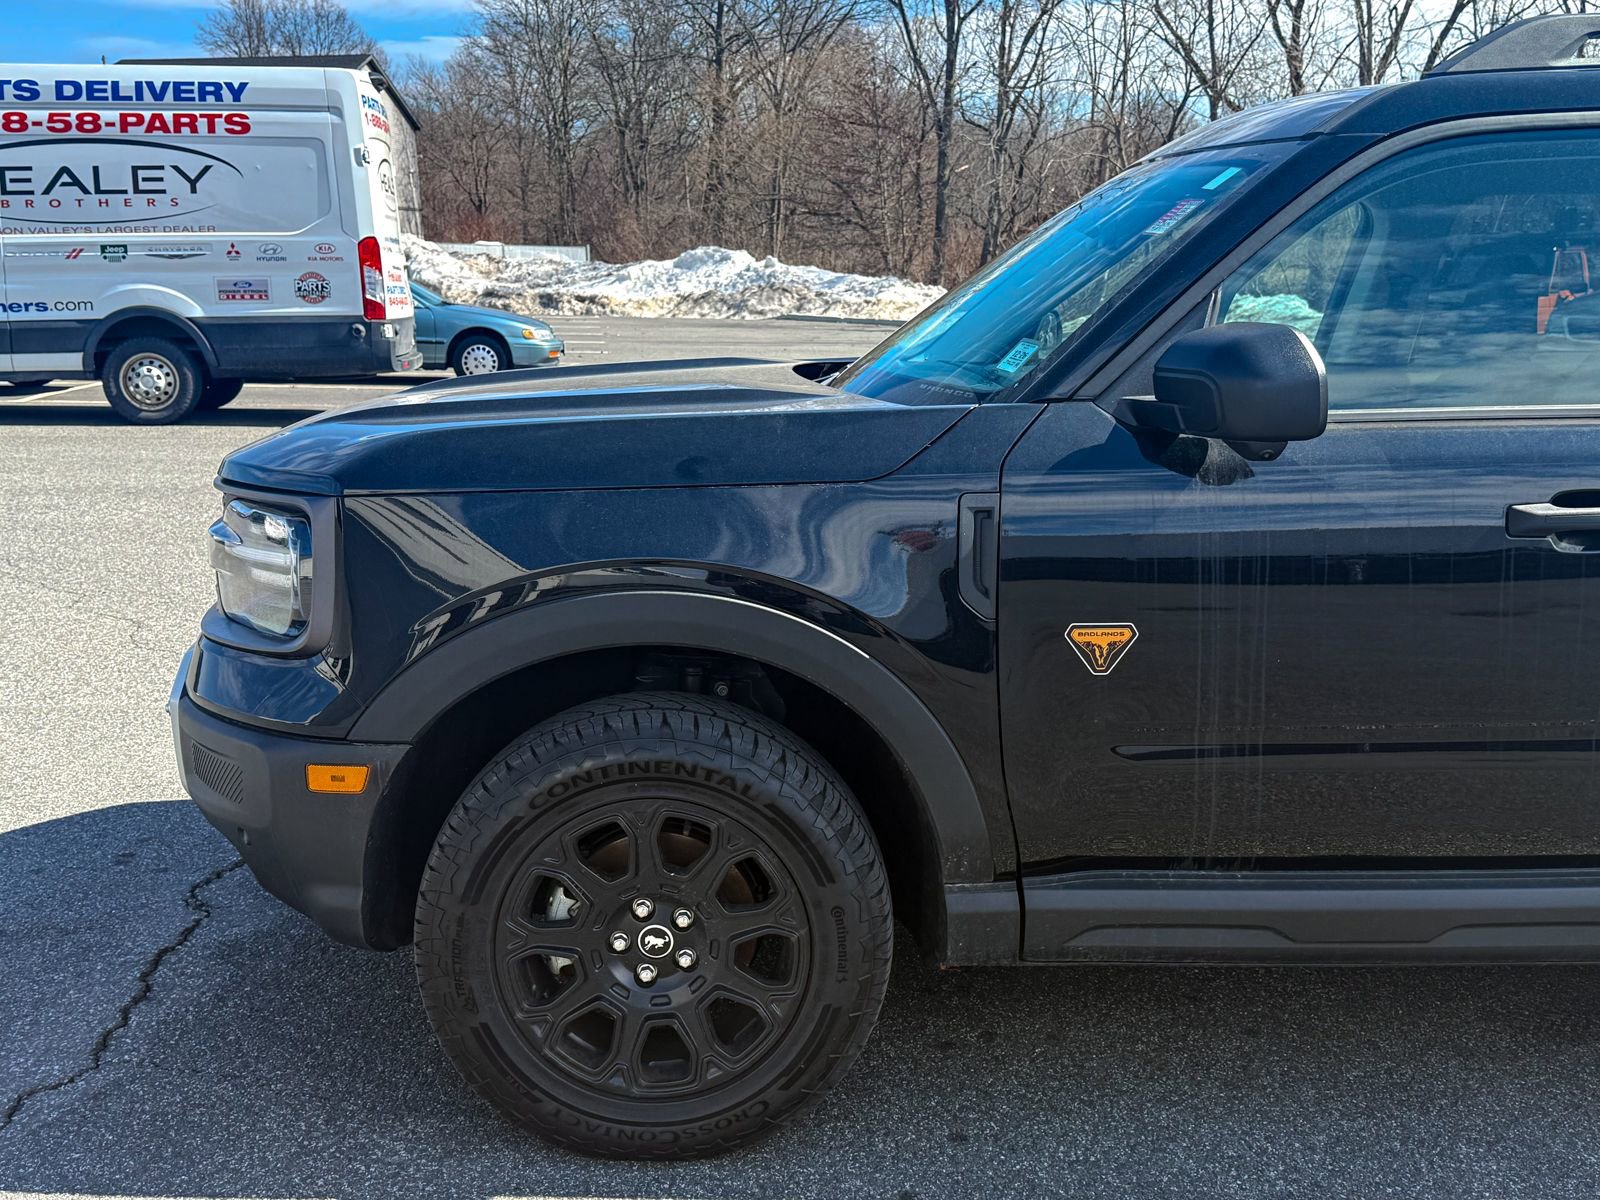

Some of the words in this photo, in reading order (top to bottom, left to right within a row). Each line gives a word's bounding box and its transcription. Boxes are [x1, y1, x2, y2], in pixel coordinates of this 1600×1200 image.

[54, 80, 249, 103] DELIVERY
[1, 111, 252, 135] 8-58-PARTS
[0, 165, 213, 196] EALEY
[1, 197, 179, 208] BROTHERS
[0, 226, 24, 235] ON
[28, 226, 93, 234] VALLEY'S
[97, 225, 158, 234] LARGEST
[162, 225, 216, 233] DEALER
[104, 245, 126, 254] Jeep
[294, 280, 331, 292] PARTS
[528, 759, 761, 810] CONTINENTAL
